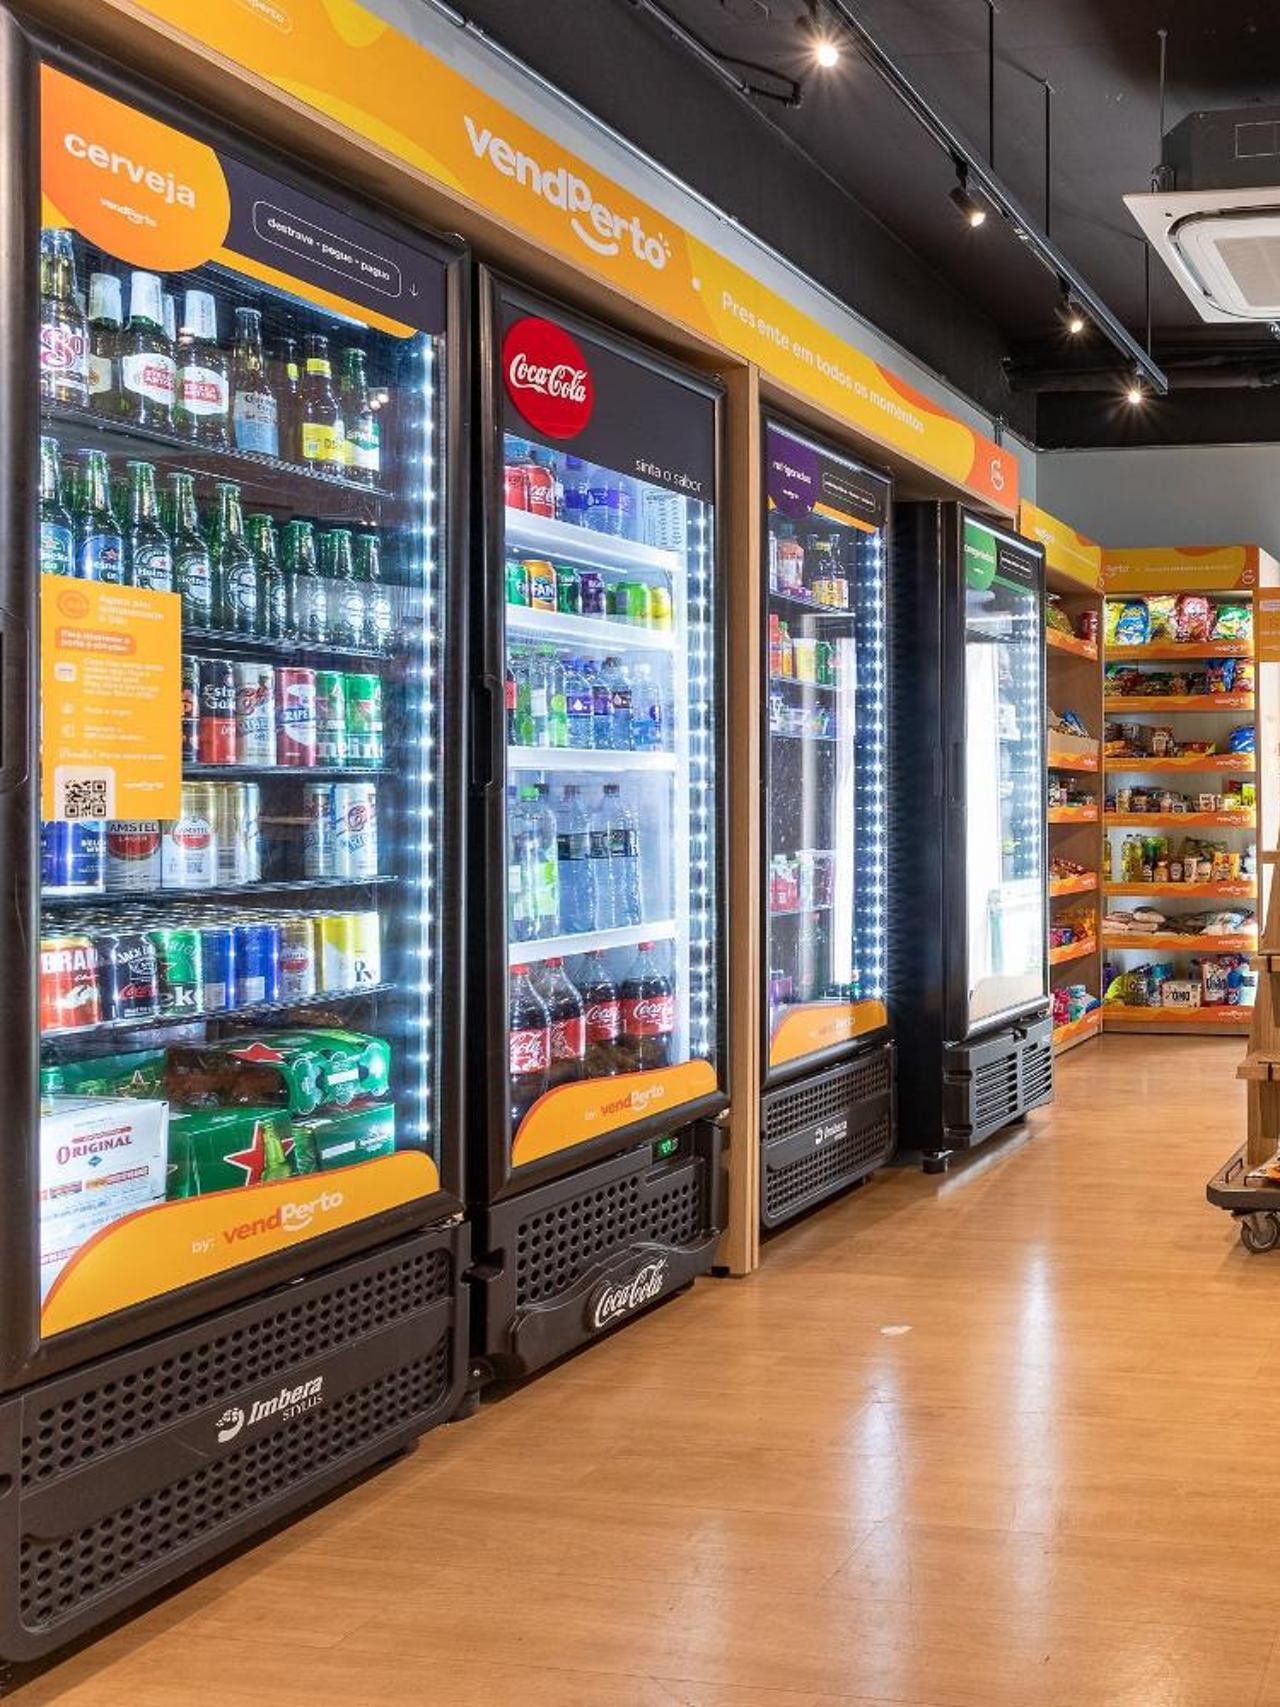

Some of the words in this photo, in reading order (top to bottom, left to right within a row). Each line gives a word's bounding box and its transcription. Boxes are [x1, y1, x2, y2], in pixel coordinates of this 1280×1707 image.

[64, 133, 196, 209] cerveja
[267, 218, 313, 246] destrave
[322, 244, 353, 264] pegue
[360, 262, 390, 281] pague
[509, 352, 588, 403] Coca-Cola
[722, 291, 789, 351] Presente
[792, 342, 814, 365] em
[816, 354, 853, 390] todos
[853, 381, 869, 399] os
[869, 391, 925, 434] momentos
[635, 458, 662, 480] sinta
[663, 470, 672, 482] o
[673, 473, 703, 493] sabor
[110, 822, 157, 832] AMSTEL
[56, 1135, 133, 1166] ORIGINAL
[594, 1256, 668, 1328] Coca-Cola
[247, 1375, 323, 1426] Imbera
[282, 1393, 323, 1421] STYLUS
